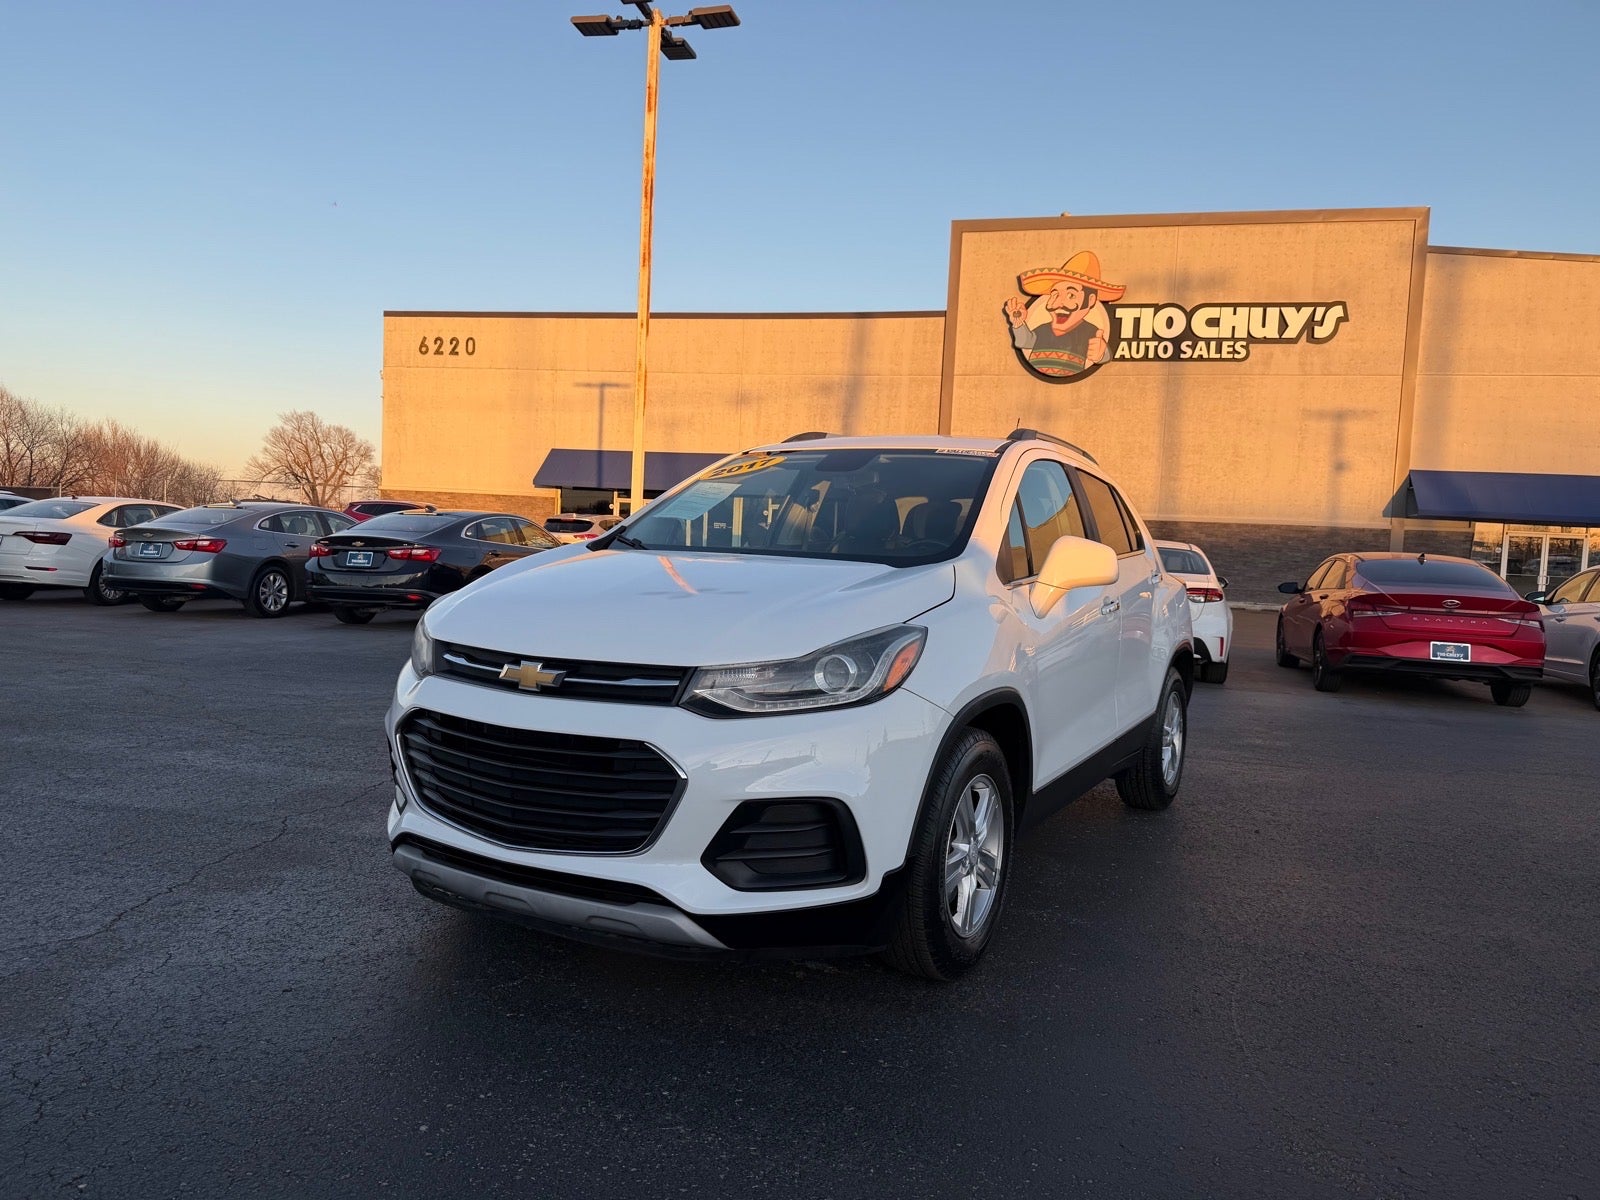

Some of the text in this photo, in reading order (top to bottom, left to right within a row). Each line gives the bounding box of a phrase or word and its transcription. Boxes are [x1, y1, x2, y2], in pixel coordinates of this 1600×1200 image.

[1115, 304, 1345, 339] TIO CHUY'S
[418, 336, 476, 356] 6220
[1114, 340, 1247, 360] AUTO SALES
[710, 458, 777, 476] 2017
